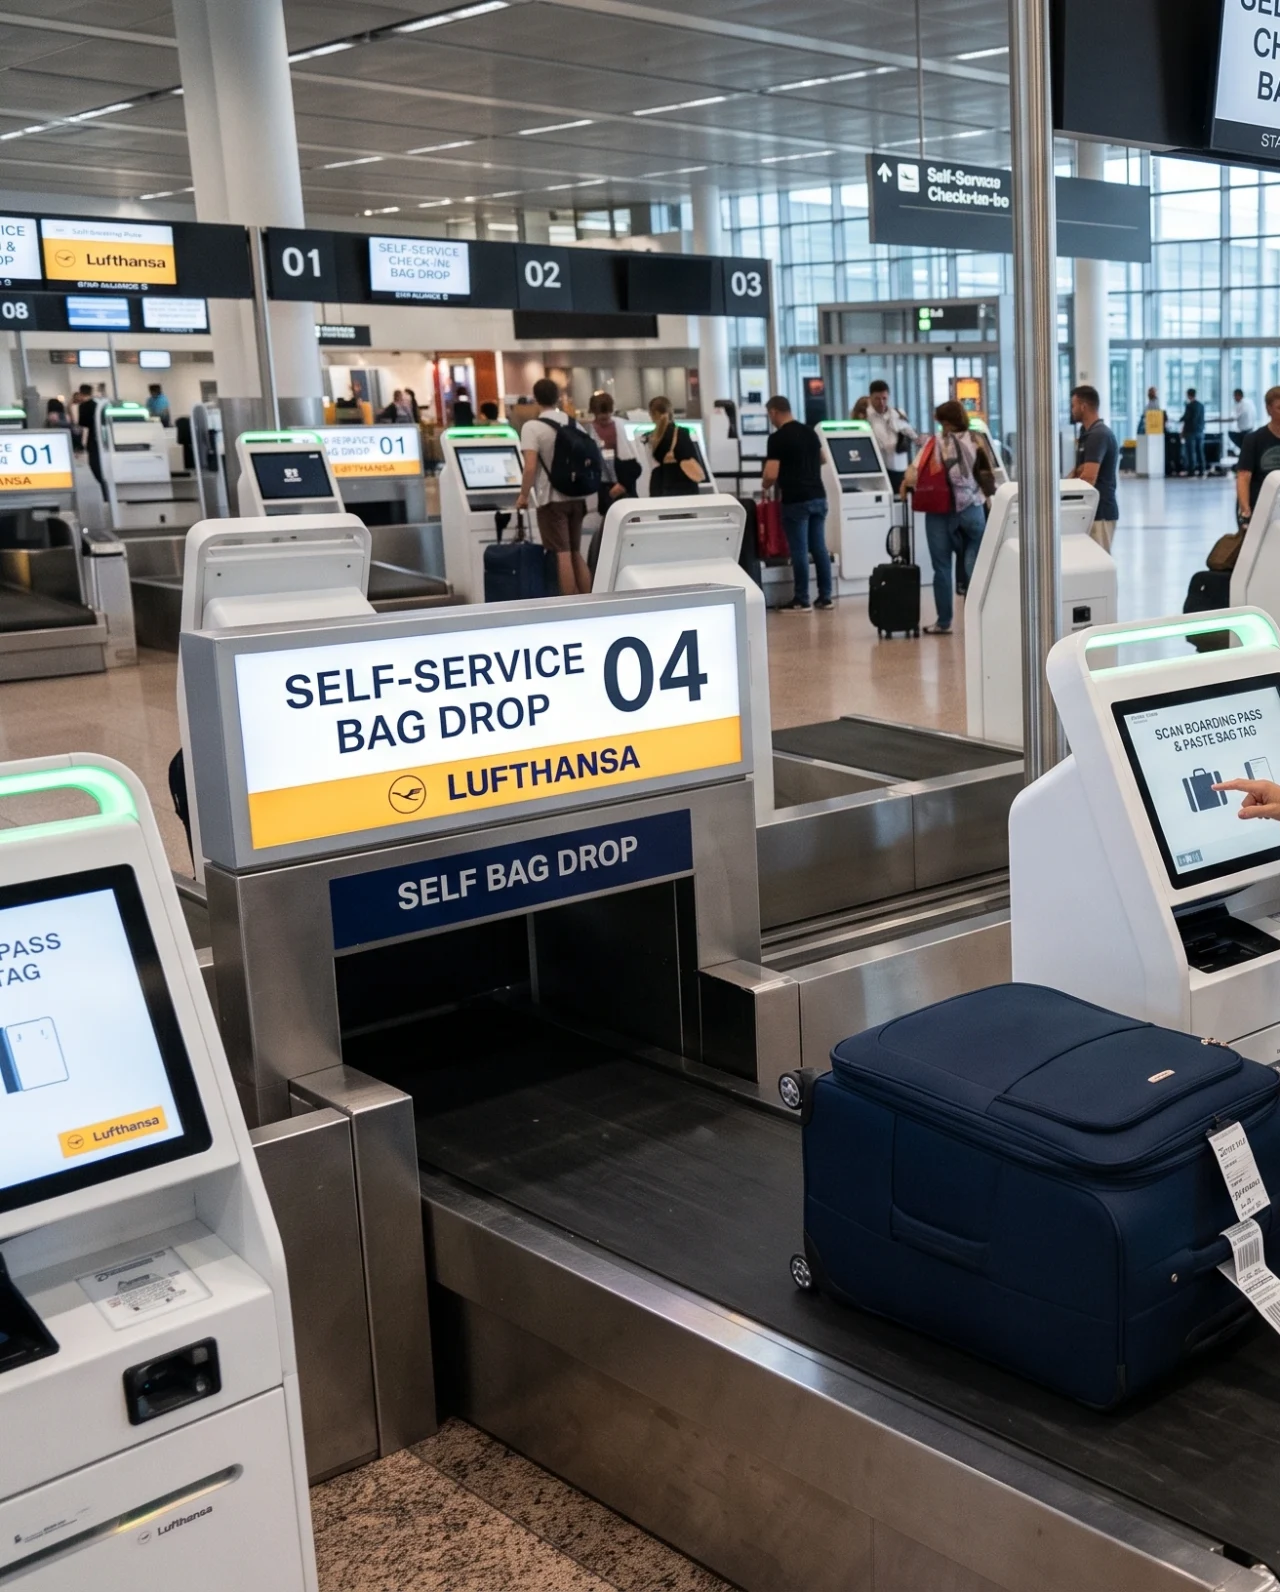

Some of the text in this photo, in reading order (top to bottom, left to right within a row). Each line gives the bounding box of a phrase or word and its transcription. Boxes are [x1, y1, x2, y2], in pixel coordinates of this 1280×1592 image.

[86, 253, 166, 269] Lufthansa
[282, 247, 322, 278] 01
[378, 243, 460, 257] SELF-SERVICE
[390, 267, 450, 280] BAG DROP
[524, 260, 561, 288] 02
[731, 271, 763, 297] 03
[2, 301, 29, 319] 08
[21, 444, 52, 465] 01
[379, 436, 405, 455] 01
[284, 642, 585, 710] SELF-SERVICE
[603, 628, 708, 712] 04
[336, 694, 551, 754] BAG DROP
[1155, 708, 1263, 740] SCAN BOARDING PASS
[1174, 740, 1182, 752] &
[1183, 733, 1216, 750] PASTE
[1237, 725, 1257, 738] TAG
[447, 745, 641, 800] LUFTHANSA
[397, 835, 639, 911] SELF BAG DROP
[93, 1115, 160, 1142] Lufthansa
